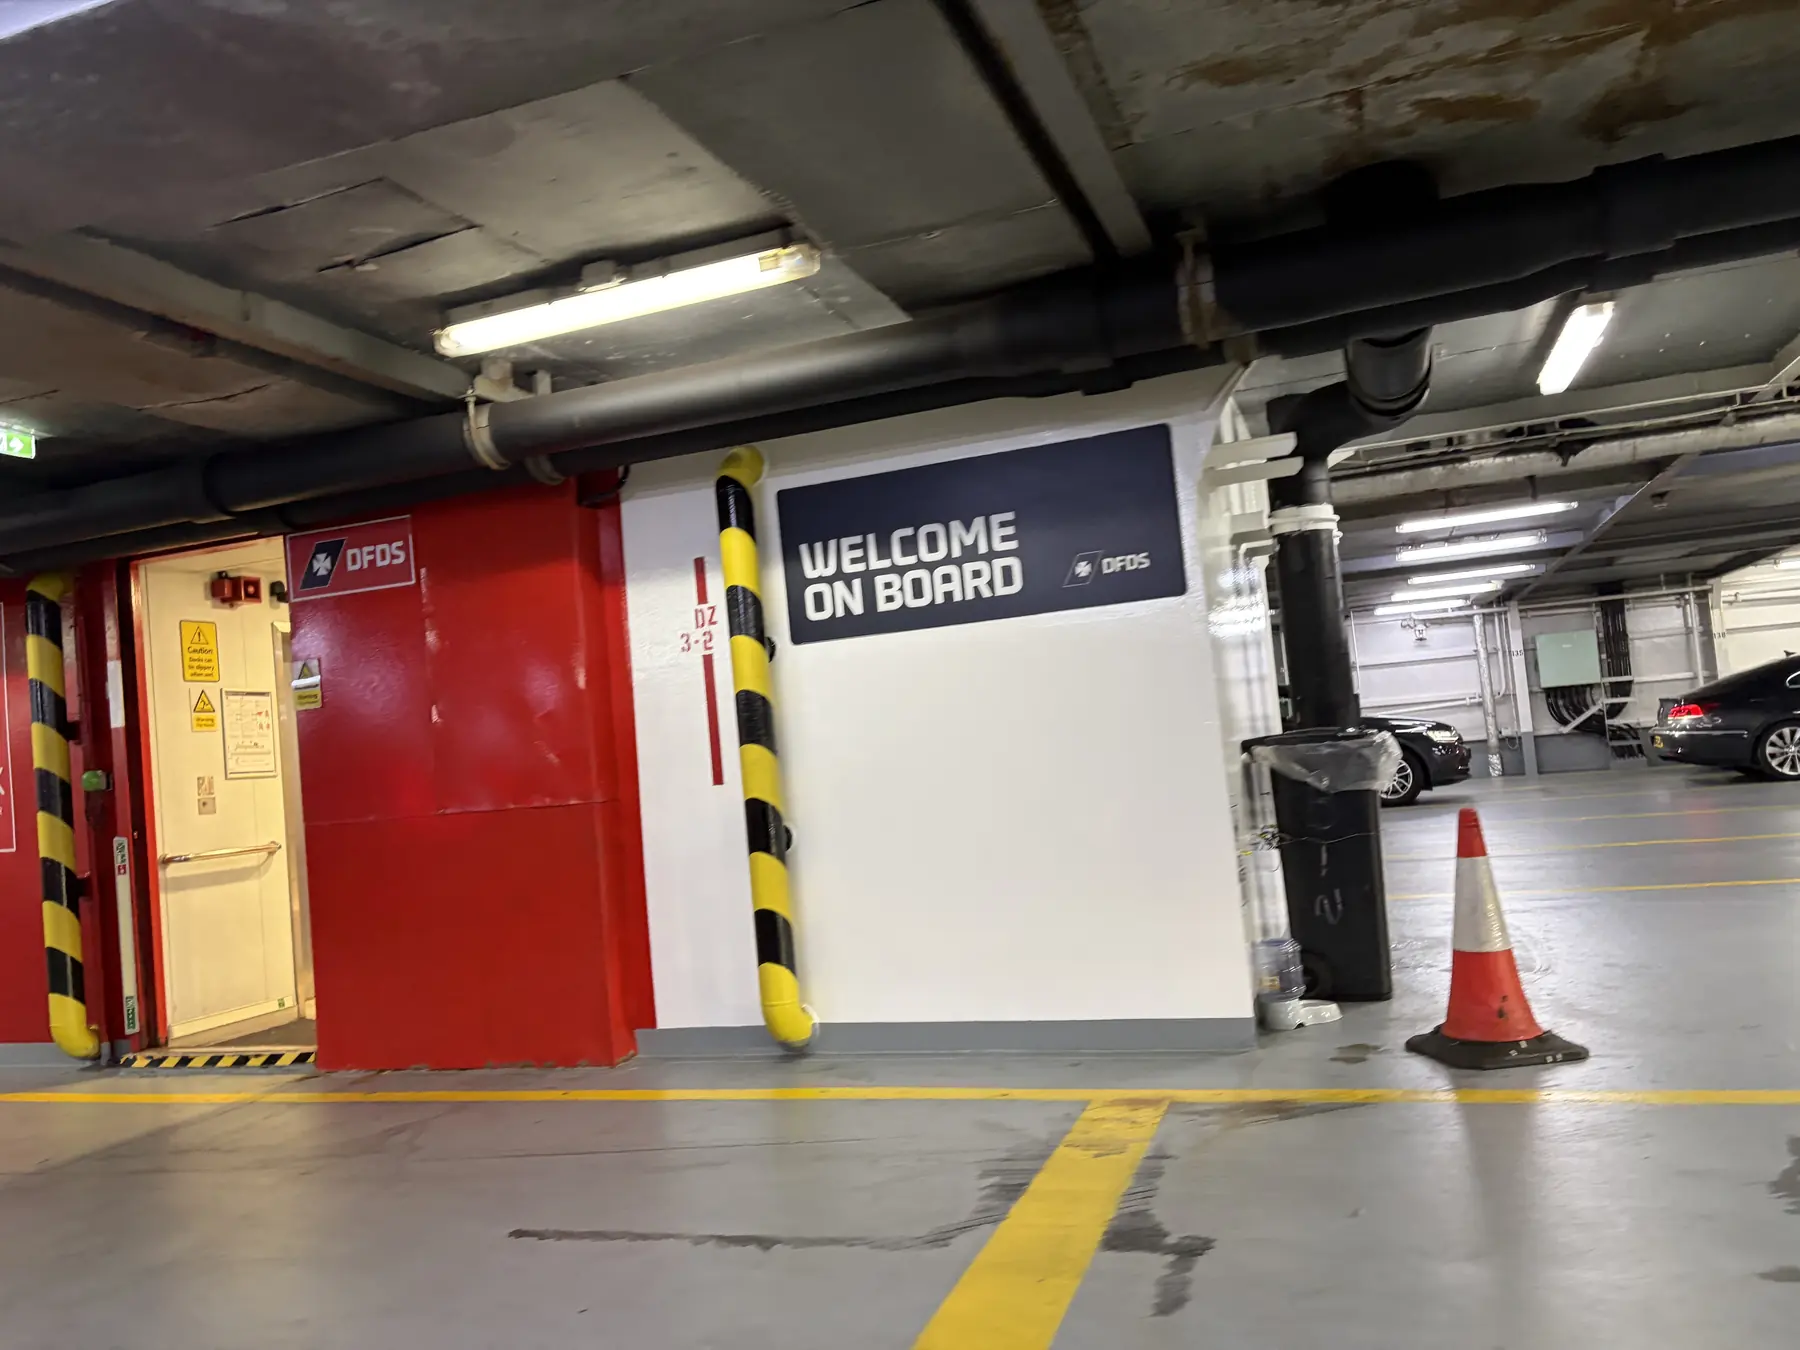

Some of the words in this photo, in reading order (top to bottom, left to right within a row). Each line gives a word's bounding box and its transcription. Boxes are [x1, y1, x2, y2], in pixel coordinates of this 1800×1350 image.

[346, 541, 406, 572] DFDS
[799, 511, 1019, 579] WELCOME
[1101, 552, 1151, 574] DFDS
[804, 577, 864, 621] ON
[874, 556, 1024, 612] BOARD
